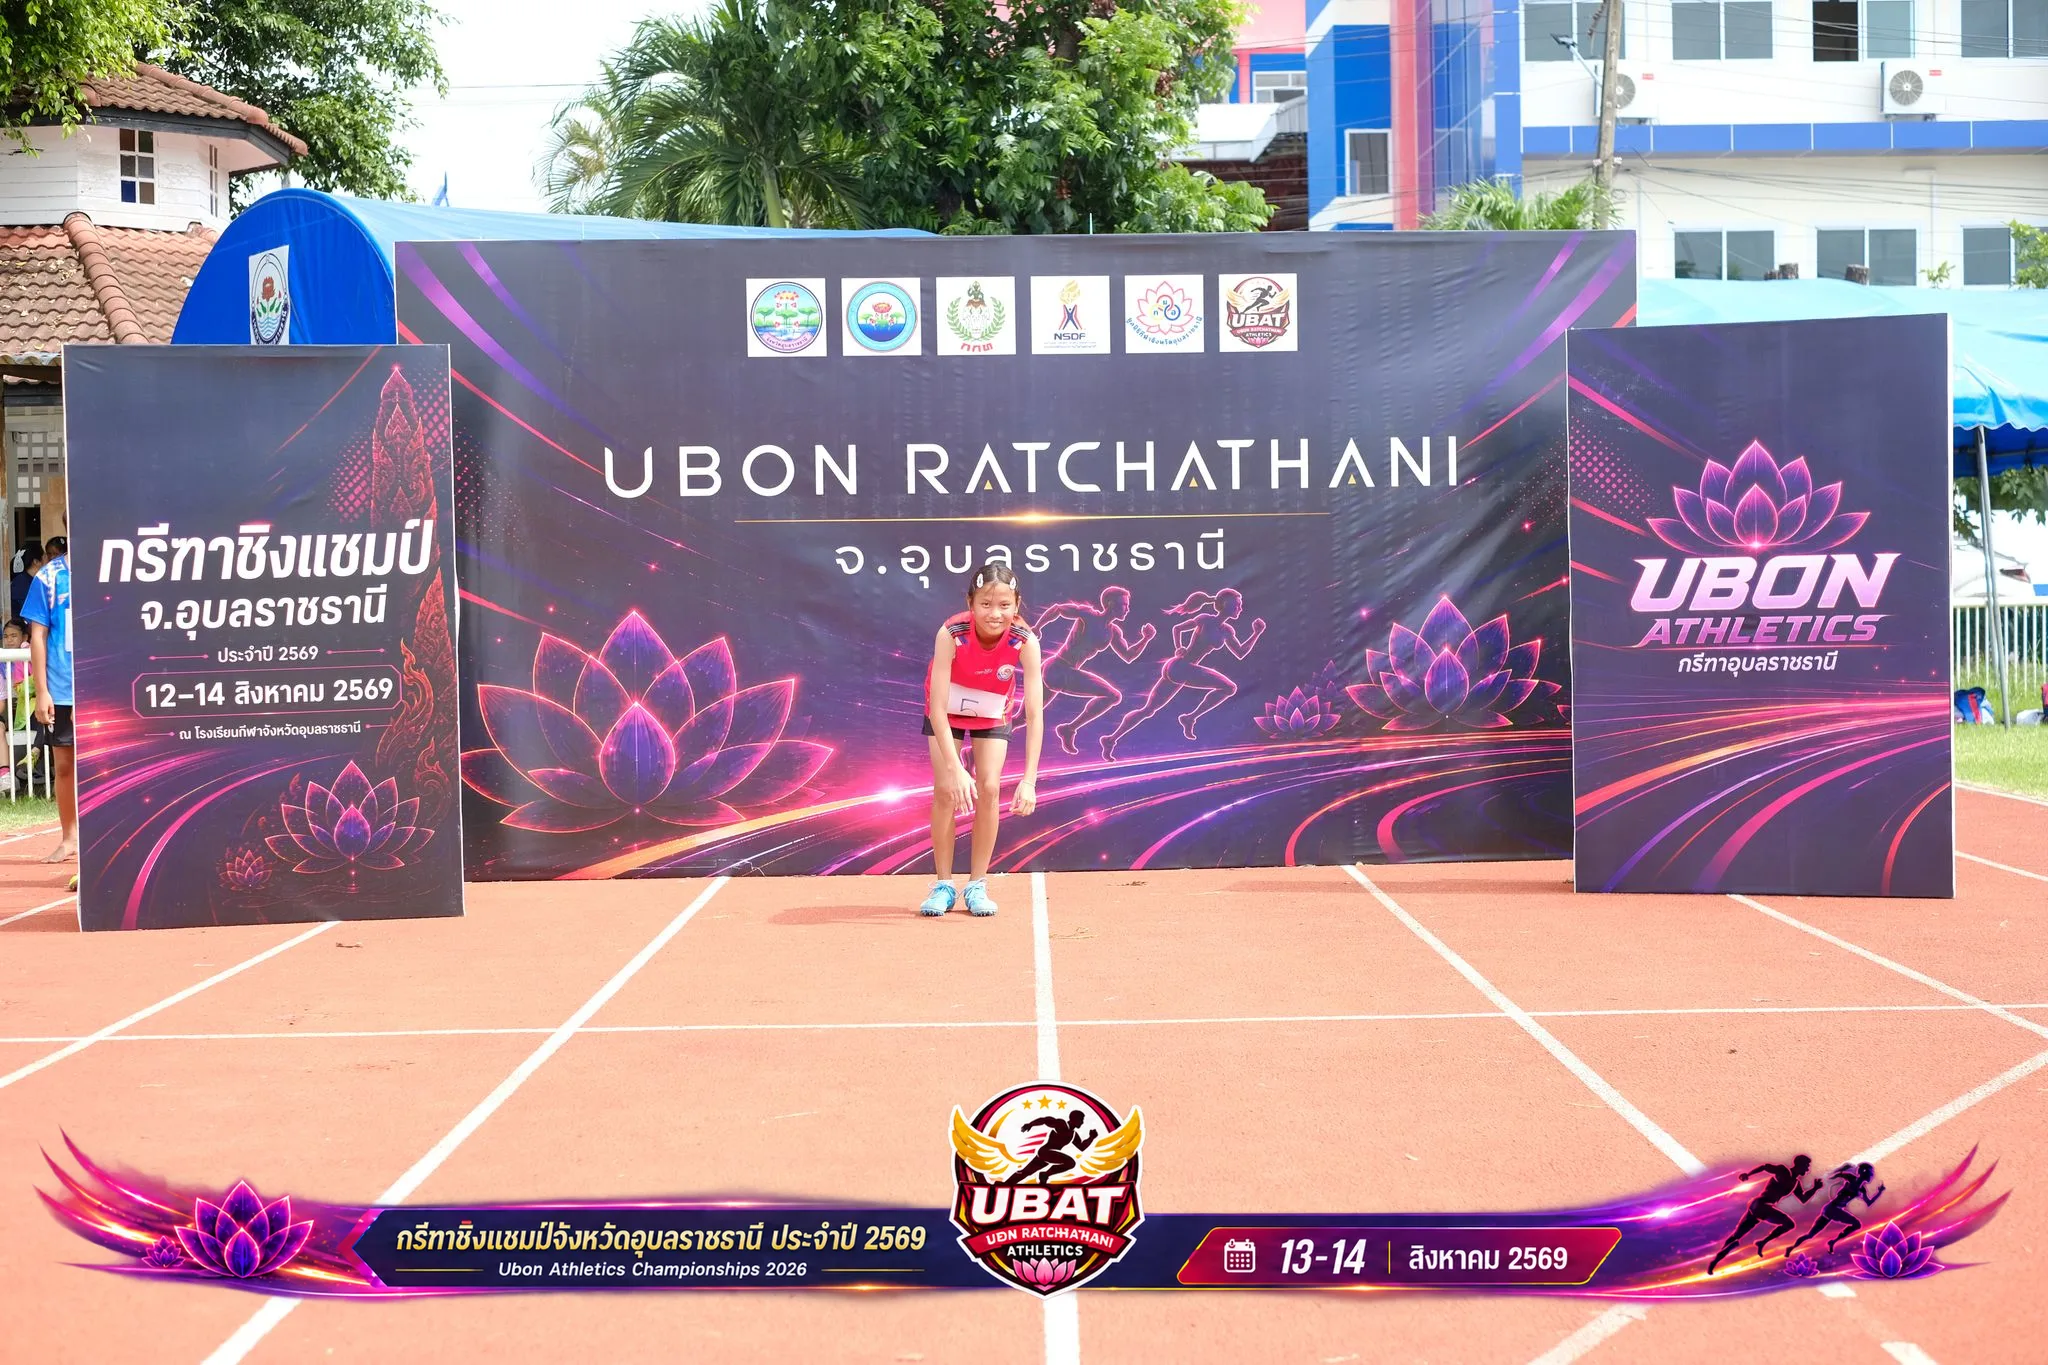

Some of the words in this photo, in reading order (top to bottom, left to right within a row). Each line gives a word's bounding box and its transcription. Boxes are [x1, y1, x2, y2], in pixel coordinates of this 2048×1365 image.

[1232, 313, 1286, 328] UBAT
[1054, 333, 1086, 341] NSDF
[604, 443, 857, 499] UBON
[906, 436, 1457, 494] RATCHATHANI
[98, 518, 434, 583] กรีฑาชิงแชมป์
[834, 527, 1226, 589] จ.อุบลราชธานี
[1631, 553, 1902, 612] UBON
[140, 583, 388, 641] จ.อุบลราชธานี
[1630, 614, 1894, 648] ATHLETICS
[217, 645, 274, 663] ประจำปี
[278, 645, 319, 662] 2569
[1678, 650, 1839, 678] กรีฑาอุบลราชธานี
[234, 680, 325, 705] สิงหาคม
[333, 677, 393, 701] 2569
[960, 698, 979, 717] 5
[179, 729, 192, 741] ณ
[195, 720, 361, 740] โรงเรียนกีฬาจังหวัดอุบลราชธานี
